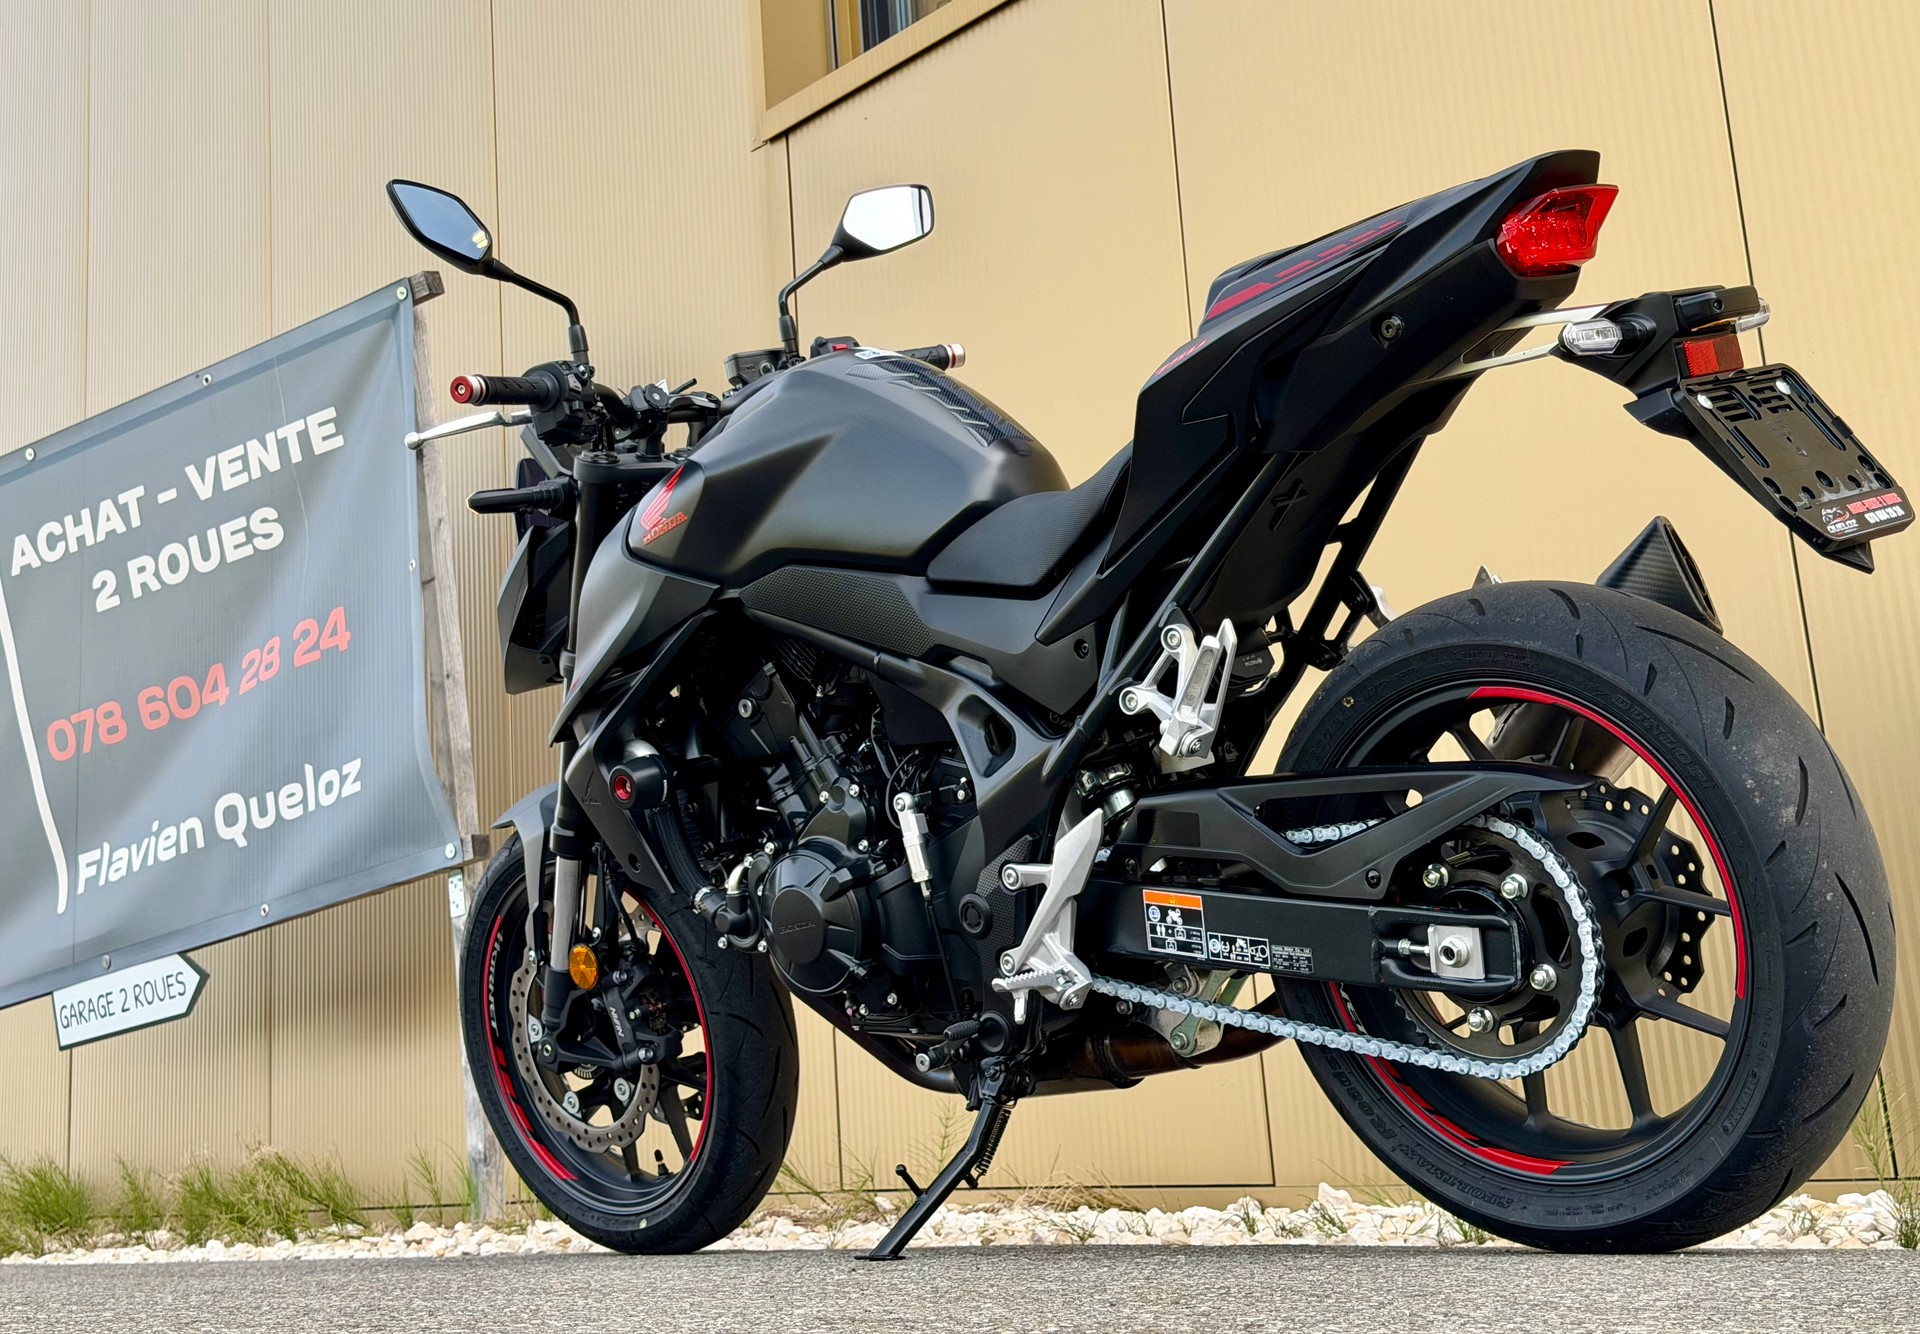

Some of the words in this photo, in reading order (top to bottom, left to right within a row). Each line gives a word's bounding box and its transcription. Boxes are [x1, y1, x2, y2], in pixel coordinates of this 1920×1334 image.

[10, 485, 146, 577] ACHAT
[184, 406, 345, 501] VENTE
[642, 511, 688, 546] HONDA
[91, 569, 121, 613] 2
[126, 506, 285, 599] ROUES
[46, 700, 128, 762] 078
[137, 662, 230, 731] 604
[238, 635, 281, 697] 28
[292, 606, 352, 668] 24
[76, 816, 205, 896] Flavien
[214, 757, 363, 848] Queloz
[60, 991, 116, 1029] GARAGE
[119, 988, 131, 1013] 2
[133, 971, 187, 1009] ROUES
